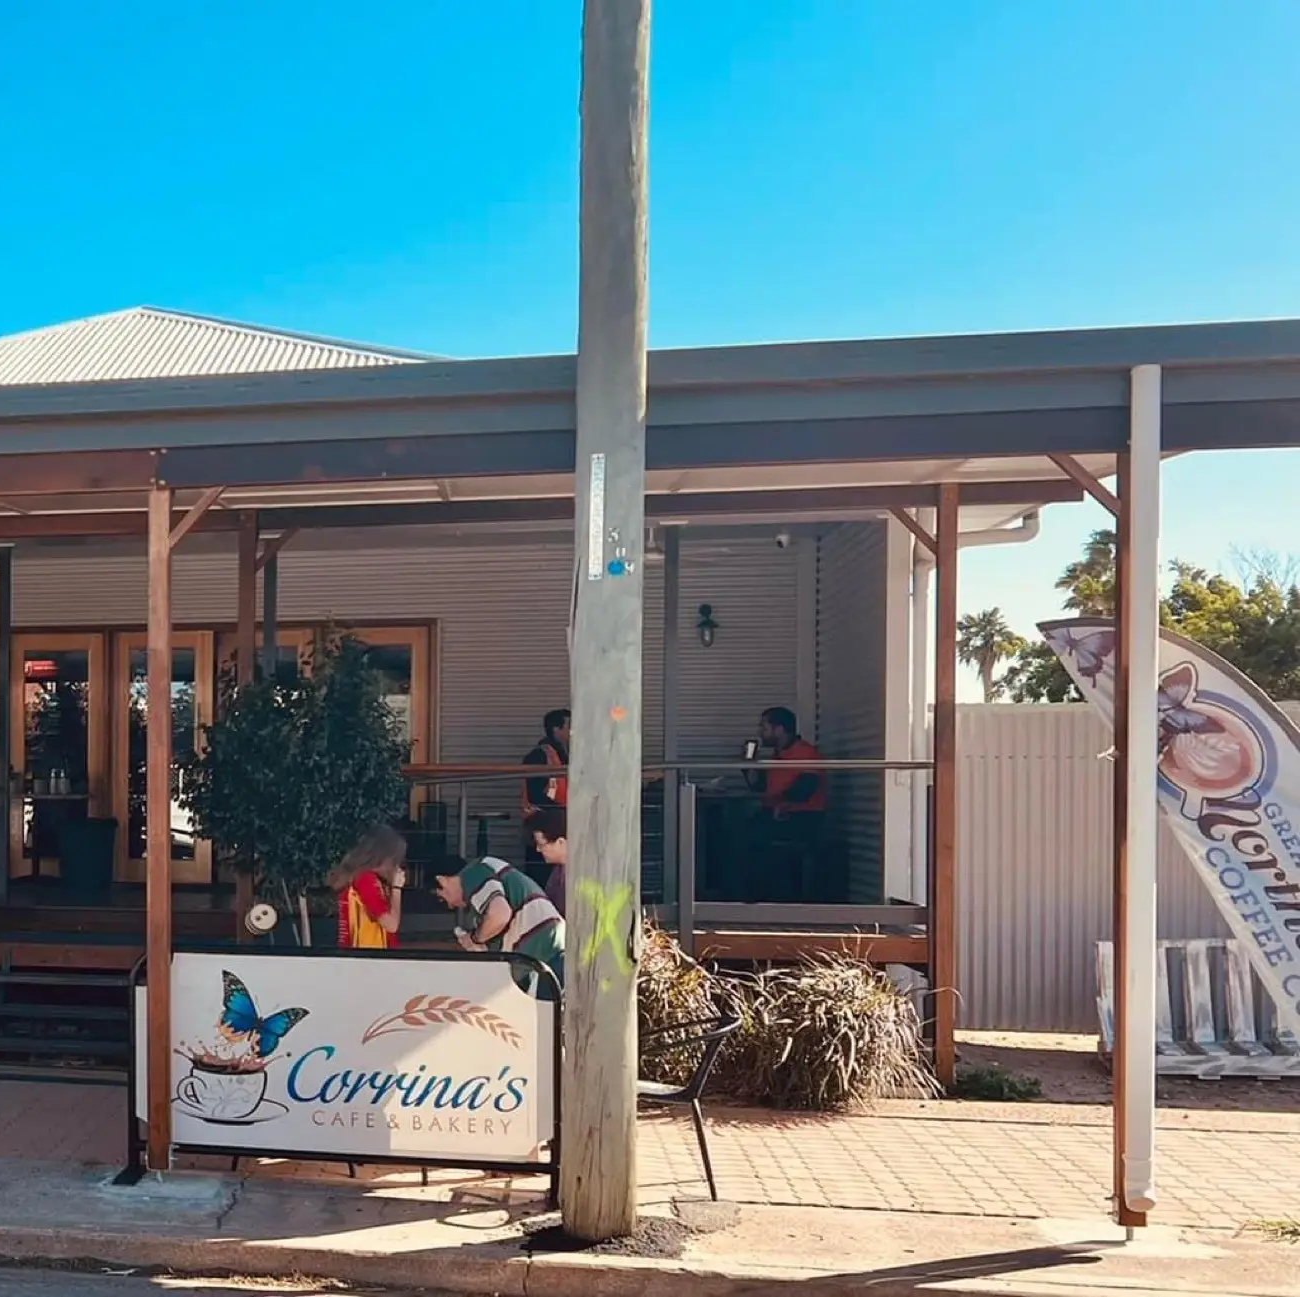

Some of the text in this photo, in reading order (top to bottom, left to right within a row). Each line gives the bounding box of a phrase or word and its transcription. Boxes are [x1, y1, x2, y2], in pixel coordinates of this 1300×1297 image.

[1205, 847, 1293, 967] COFFEE
[287, 1045, 529, 1113] Corrina's
[312, 1110, 513, 1135] CAFE & BAKERY
